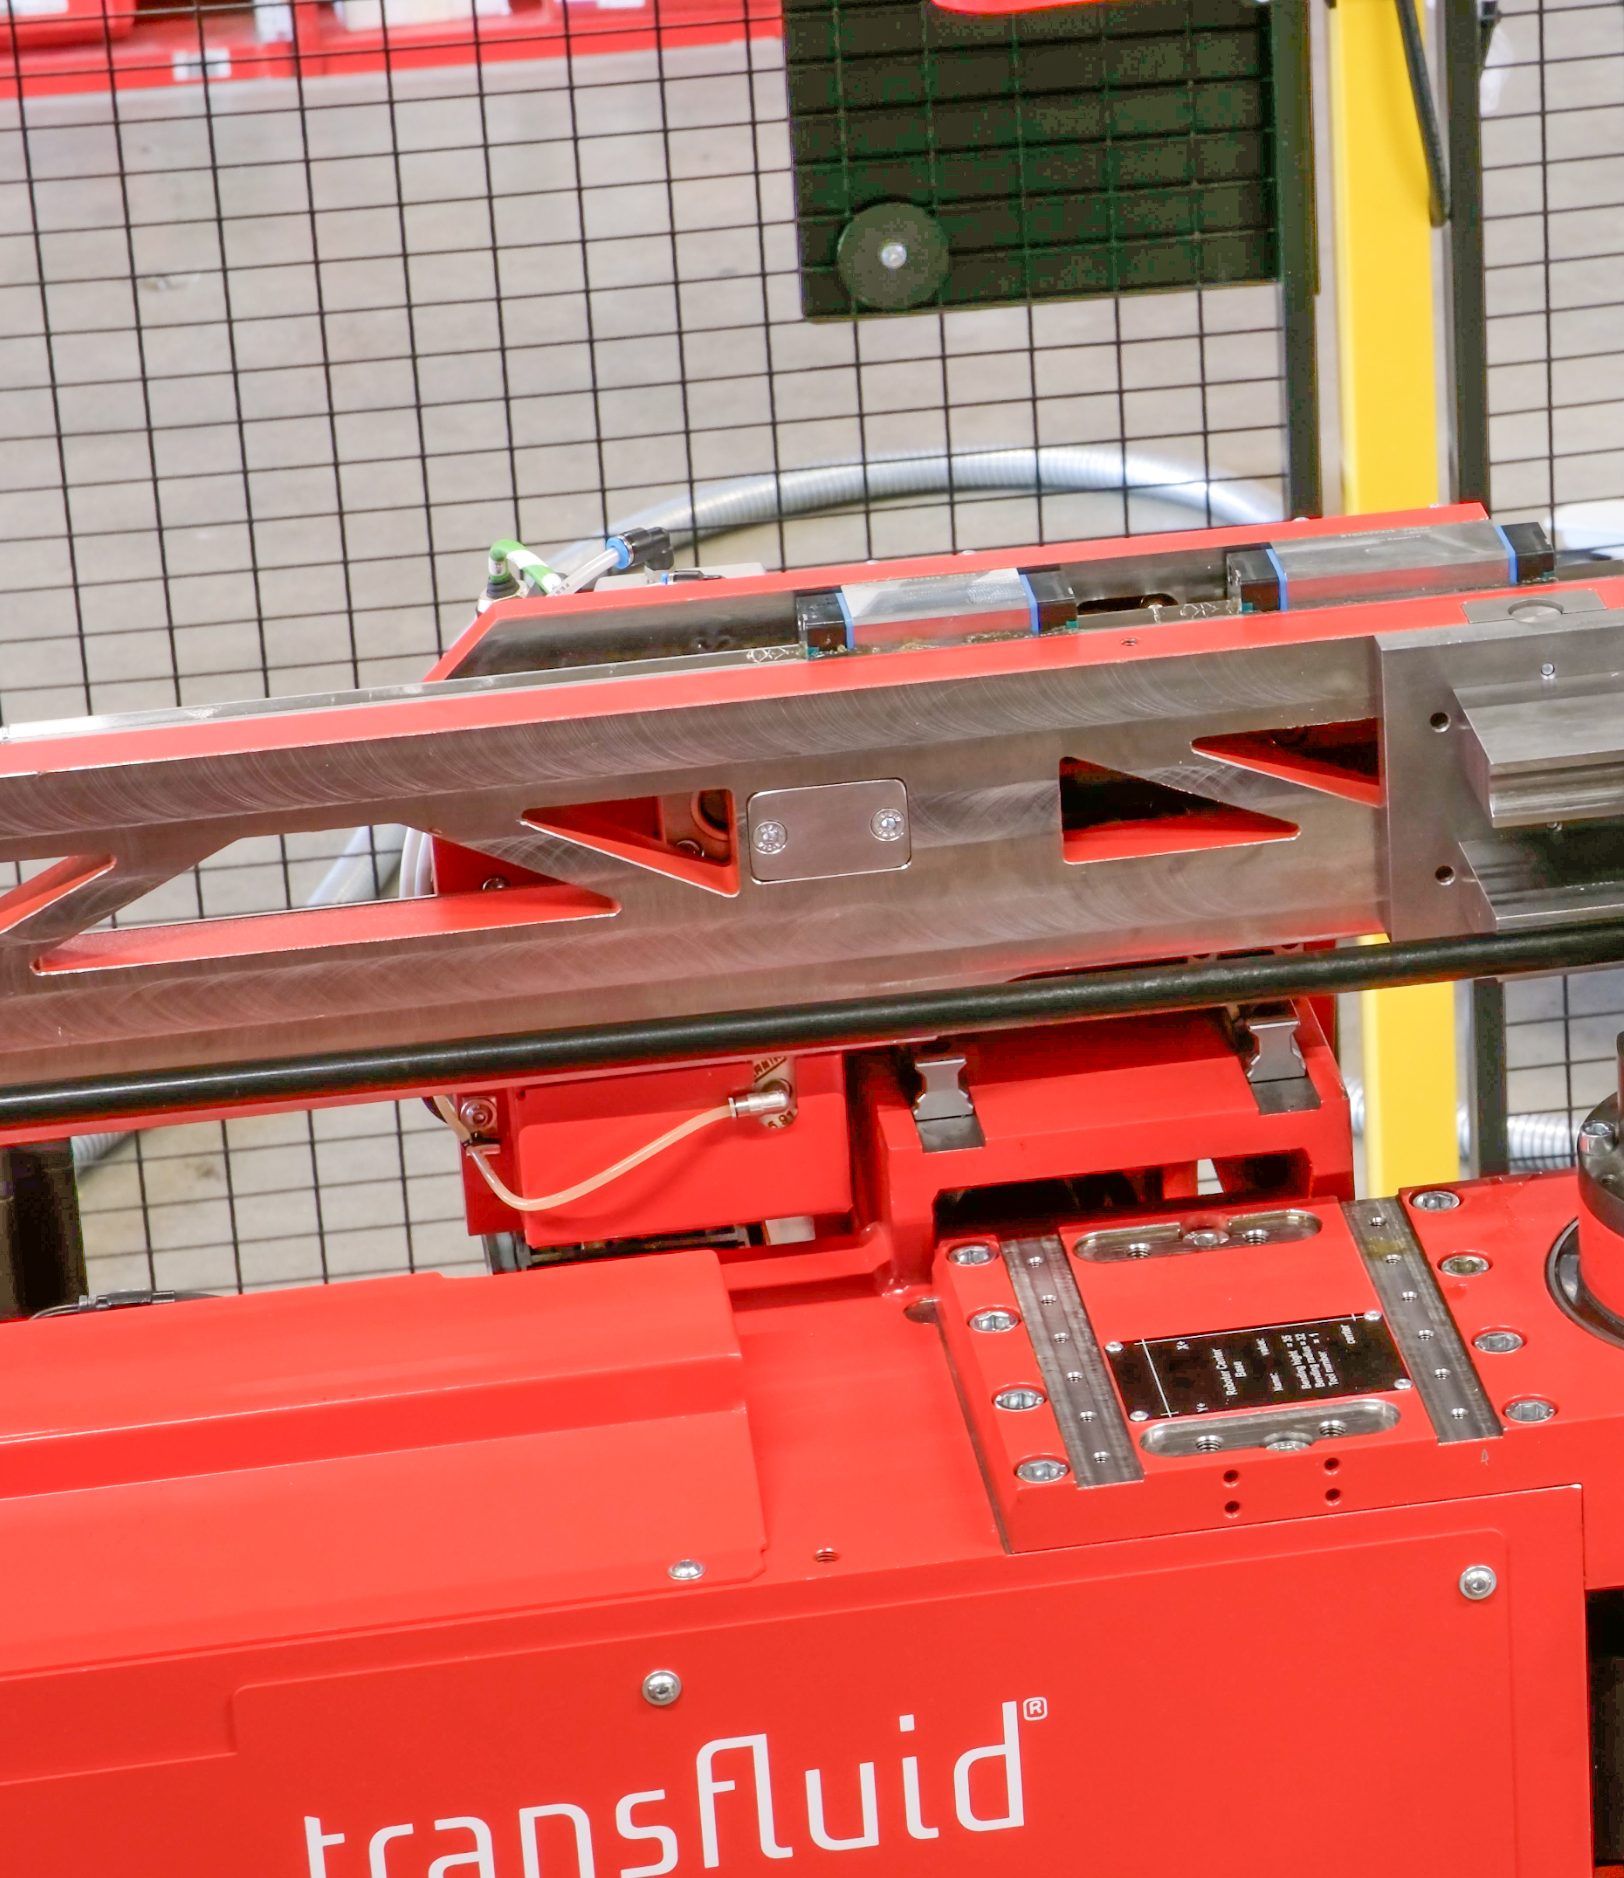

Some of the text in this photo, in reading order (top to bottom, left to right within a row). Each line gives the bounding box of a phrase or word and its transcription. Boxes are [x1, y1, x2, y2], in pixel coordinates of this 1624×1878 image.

[1340, 1323, 1356, 1345] center
[1302, 1345, 1316, 1364] radius
[1318, 1350, 1334, 1373] number
[1211, 1348, 1238, 1396] Roboter Center
[1233, 1360, 1247, 1378] Base
[1296, 1365, 1312, 1390] Bending
[1309, 1363, 1326, 1388] Bending
[1325, 1373, 1339, 1387] Tool
